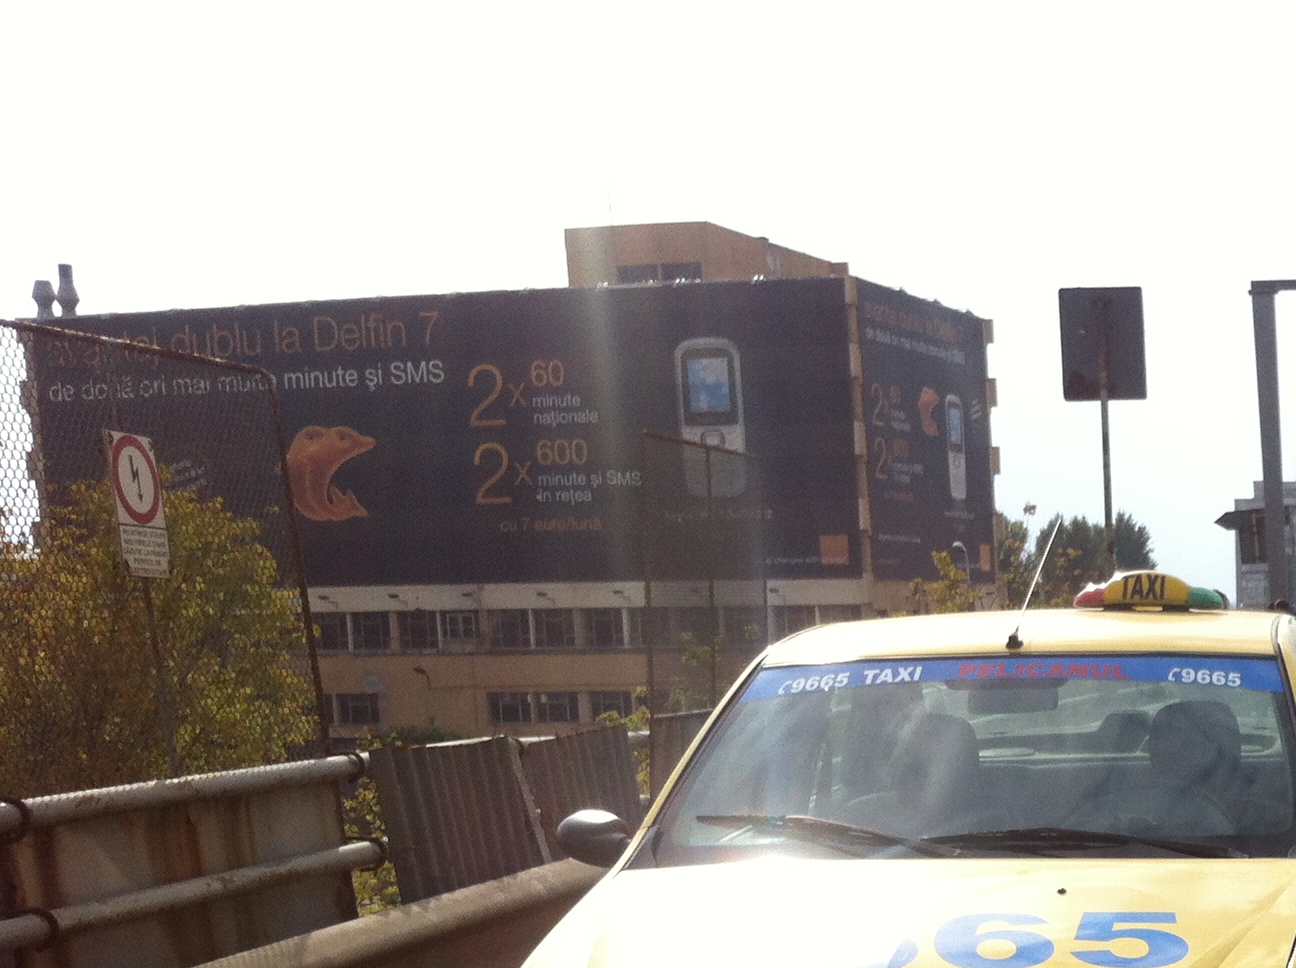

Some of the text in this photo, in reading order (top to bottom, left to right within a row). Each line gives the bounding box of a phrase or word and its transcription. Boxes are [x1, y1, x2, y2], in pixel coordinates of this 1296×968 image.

[274, 319, 301, 352] la
[313, 313, 407, 351] Delfin
[419, 310, 439, 348] 7
[284, 366, 359, 390] minute
[389, 359, 445, 385] SMS
[530, 359, 565, 387] 60
[532, 393, 581, 409] minute
[536, 438, 588, 466] 600
[538, 471, 587, 487] minute
[606, 469, 642, 487] SMS
[1121, 573, 1167, 601] TAXI
[789, 662, 1241, 693] 9665 TAXI PELICANUL 9665
